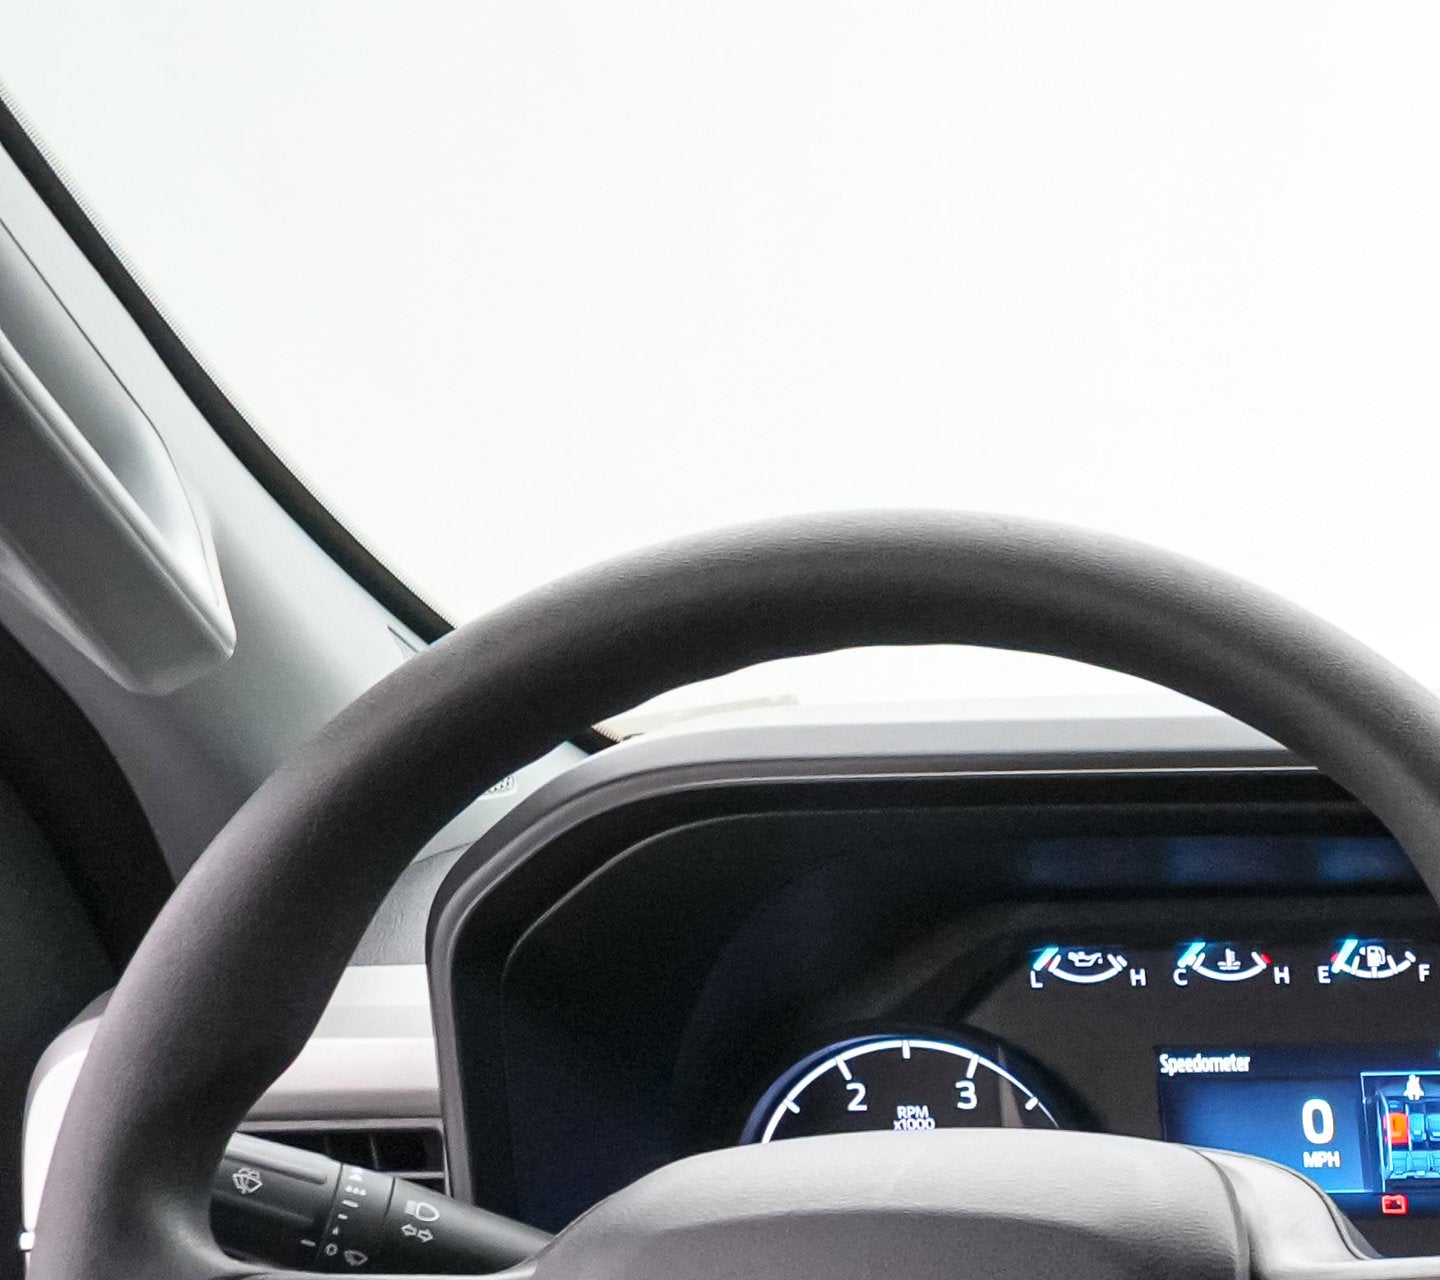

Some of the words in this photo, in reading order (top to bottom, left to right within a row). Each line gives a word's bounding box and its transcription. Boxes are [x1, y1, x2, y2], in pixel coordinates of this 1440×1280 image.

[1030, 971, 1043, 988] L
[1130, 969, 1147, 986] H
[1173, 968, 1188, 986] C
[1273, 967, 1290, 984] H
[1318, 966, 1331, 984] E
[1418, 964, 1431, 982] F
[1160, 1053, 1250, 1076] Speedometer
[846, 1082, 868, 1111] 2
[955, 1080, 978, 1109] 3
[897, 1105, 929, 1118] RPM
[893, 1117, 935, 1130] x1000
[1302, 1098, 1334, 1144] 0
[1303, 1151, 1340, 1168] MPH
